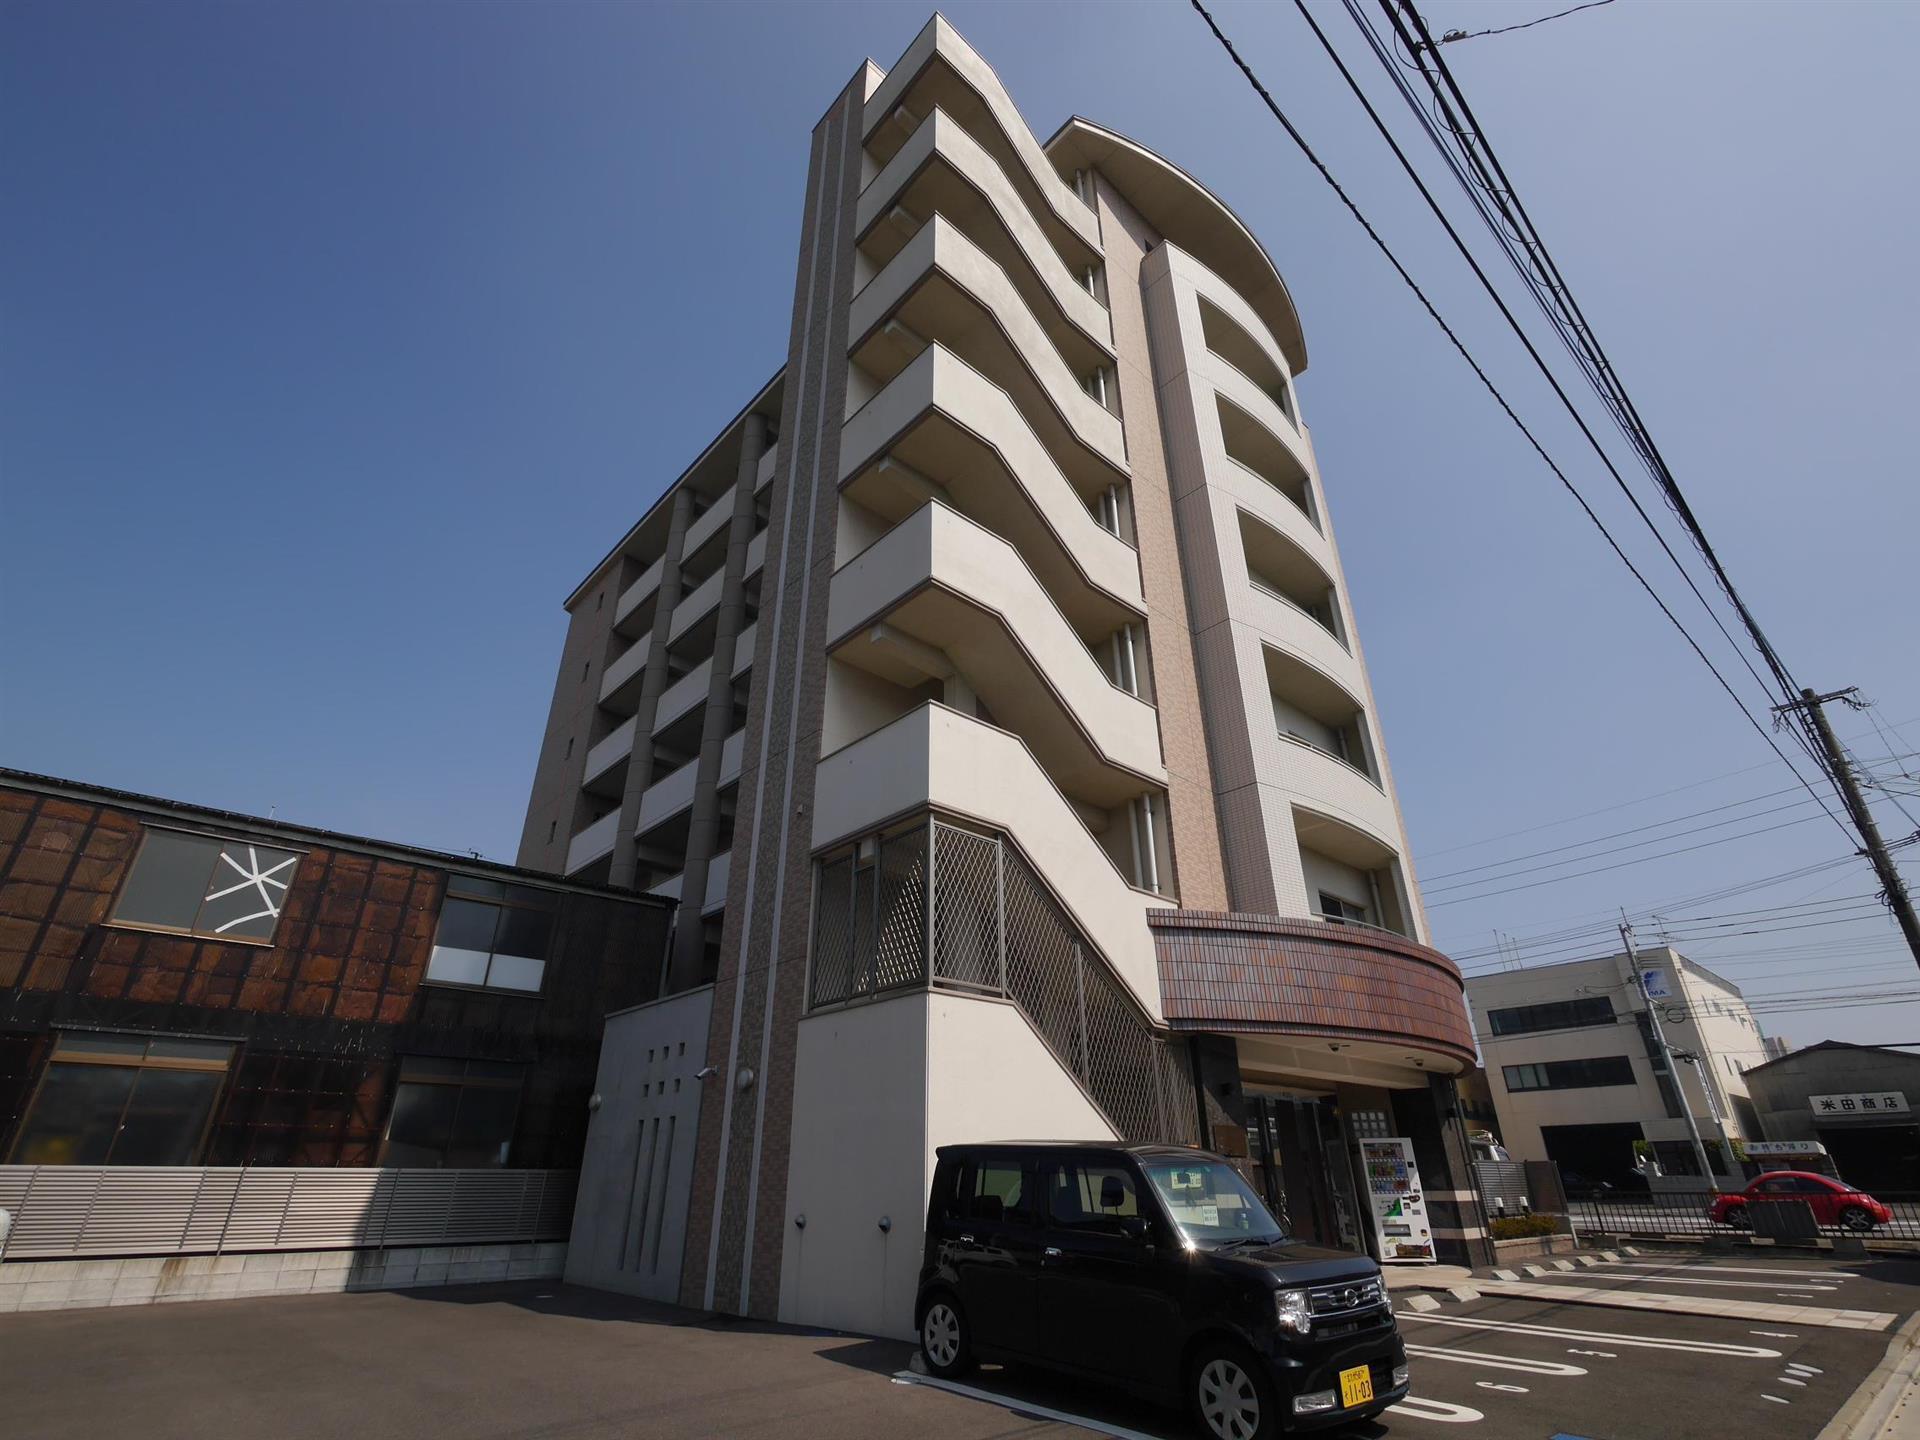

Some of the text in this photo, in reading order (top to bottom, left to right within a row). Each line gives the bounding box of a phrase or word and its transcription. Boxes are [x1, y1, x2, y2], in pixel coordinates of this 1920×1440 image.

[1820, 1097, 1898, 1111] 米田商店
[1349, 1380, 1372, 1403] 11-03
[1475, 1381, 1530, 1393] 6
